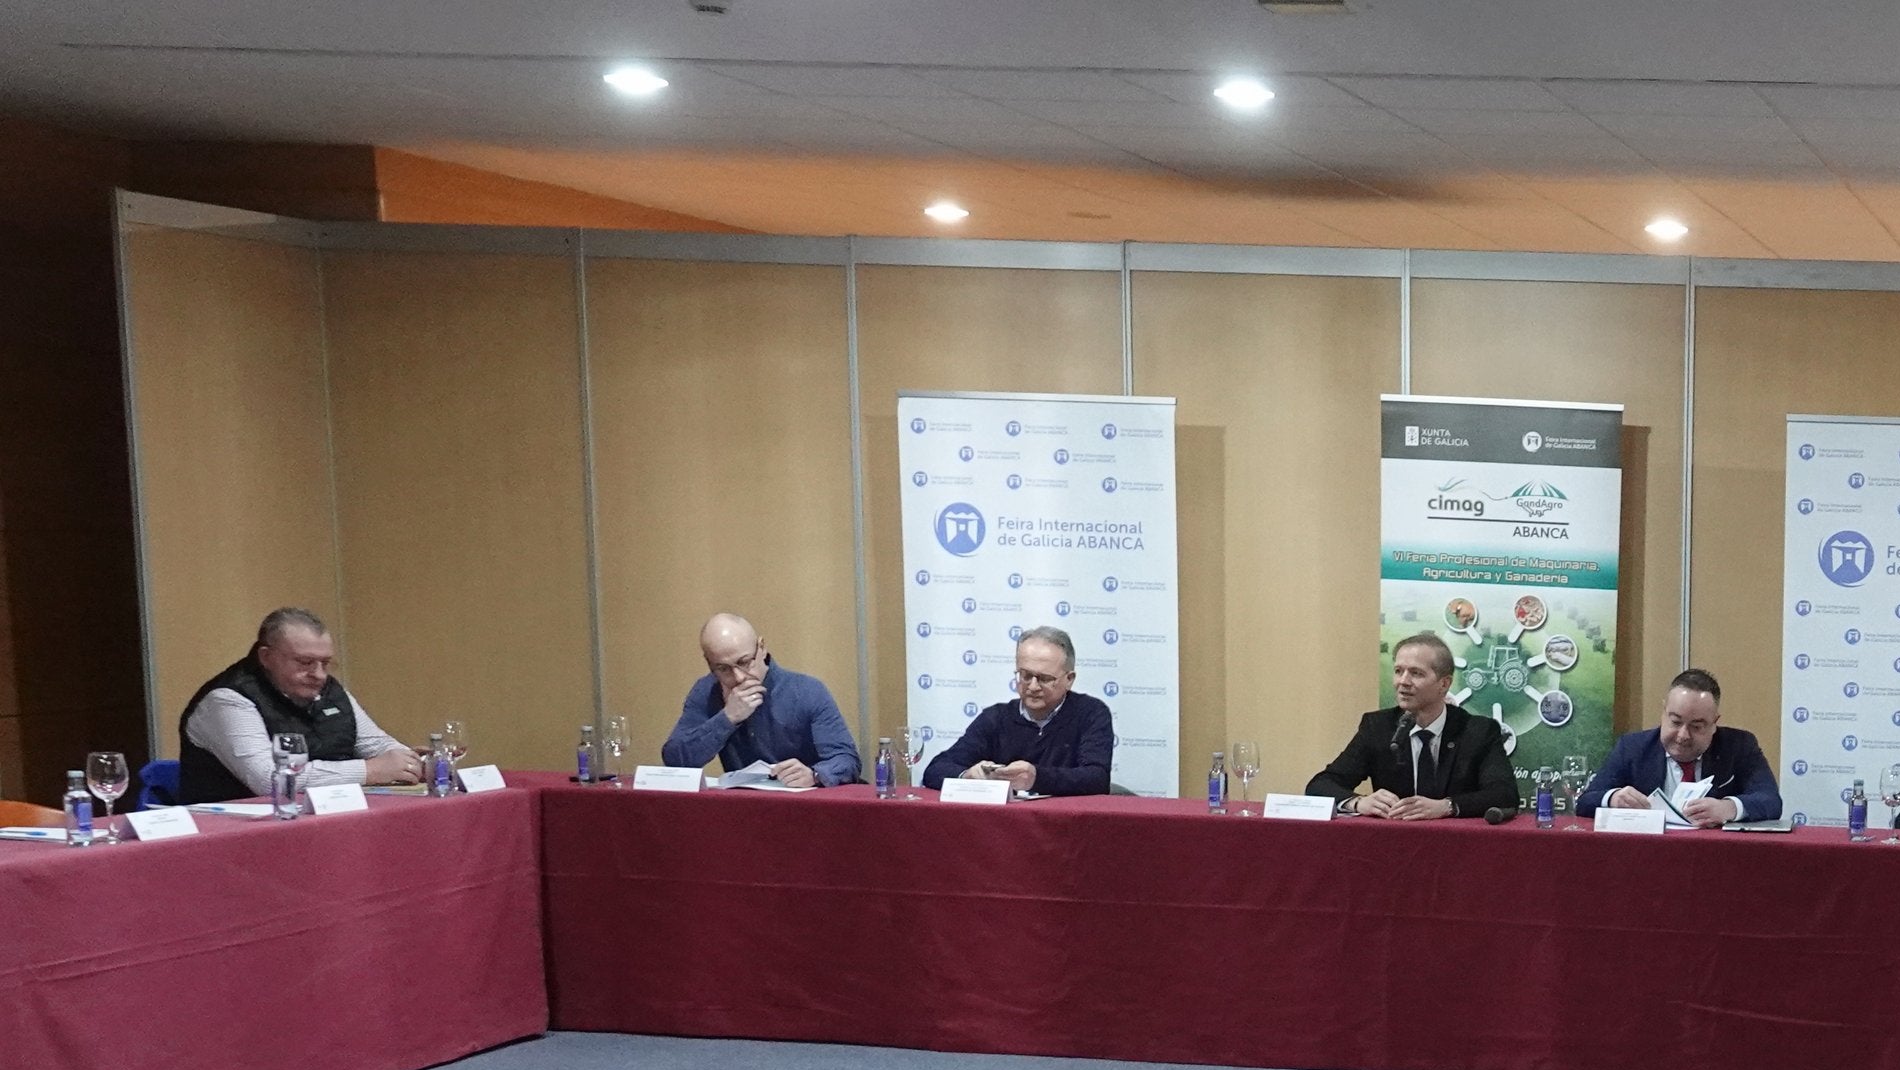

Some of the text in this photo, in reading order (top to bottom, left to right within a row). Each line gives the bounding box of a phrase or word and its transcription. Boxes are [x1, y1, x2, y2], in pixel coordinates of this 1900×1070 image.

[1421, 428, 1451, 437] XUNTA
[1421, 437, 1469, 447] DE GALICIA
[1428, 495, 1484, 516] cimag
[998, 517, 1143, 534] Feira Internacional
[1513, 526, 1569, 539] ABANCA
[997, 533, 1144, 551] de Galicia ABANCA
[1394, 551, 1404, 561] VI
[1407, 552, 1437, 563] Feria
[1439, 554, 1508, 567] Profesional
[1511, 556, 1526, 567] de
[1423, 568, 1491, 580] Agricultura
[1495, 572, 1502, 583] y
